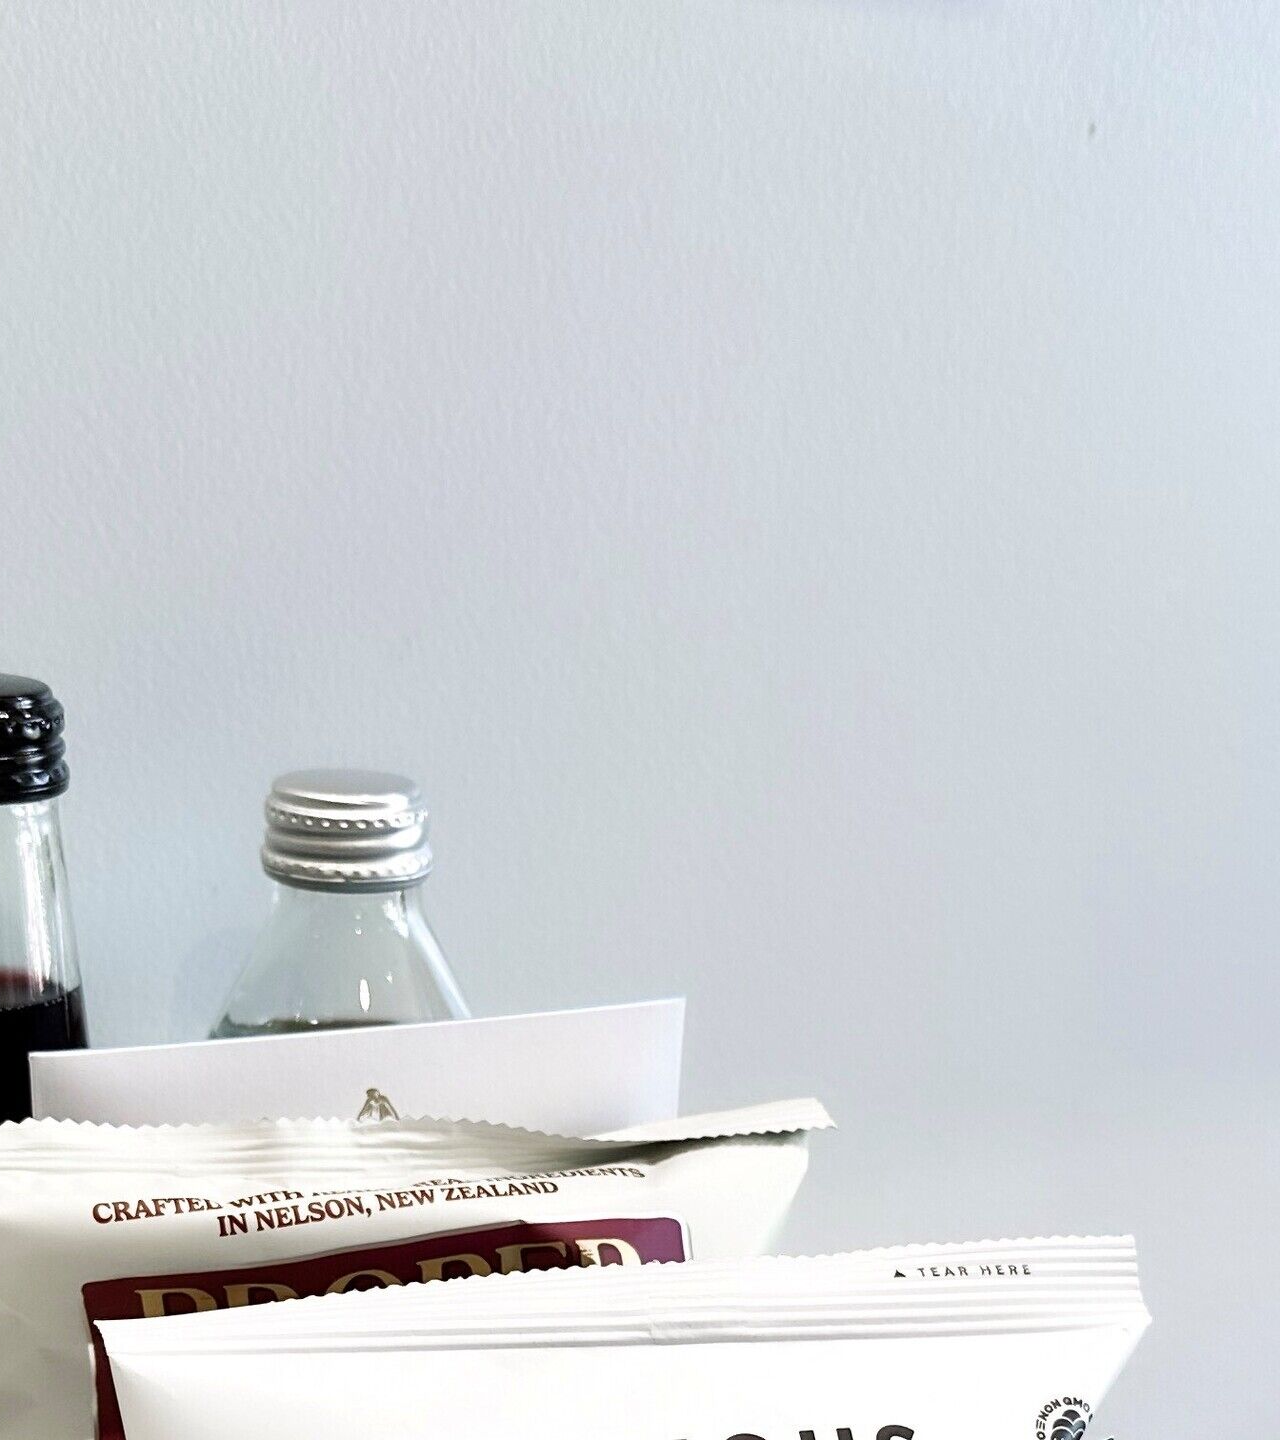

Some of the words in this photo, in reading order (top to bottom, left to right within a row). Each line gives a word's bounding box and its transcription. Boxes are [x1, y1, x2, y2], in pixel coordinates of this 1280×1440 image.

[217, 1213, 250, 1237] IN
[255, 1196, 372, 1232] NELSON,
[375, 1188, 435, 1212] NEW
[441, 1180, 559, 1202] ZEALAND
[917, 1265, 969, 1278] TEAR
[979, 1264, 1031, 1277] HERE
